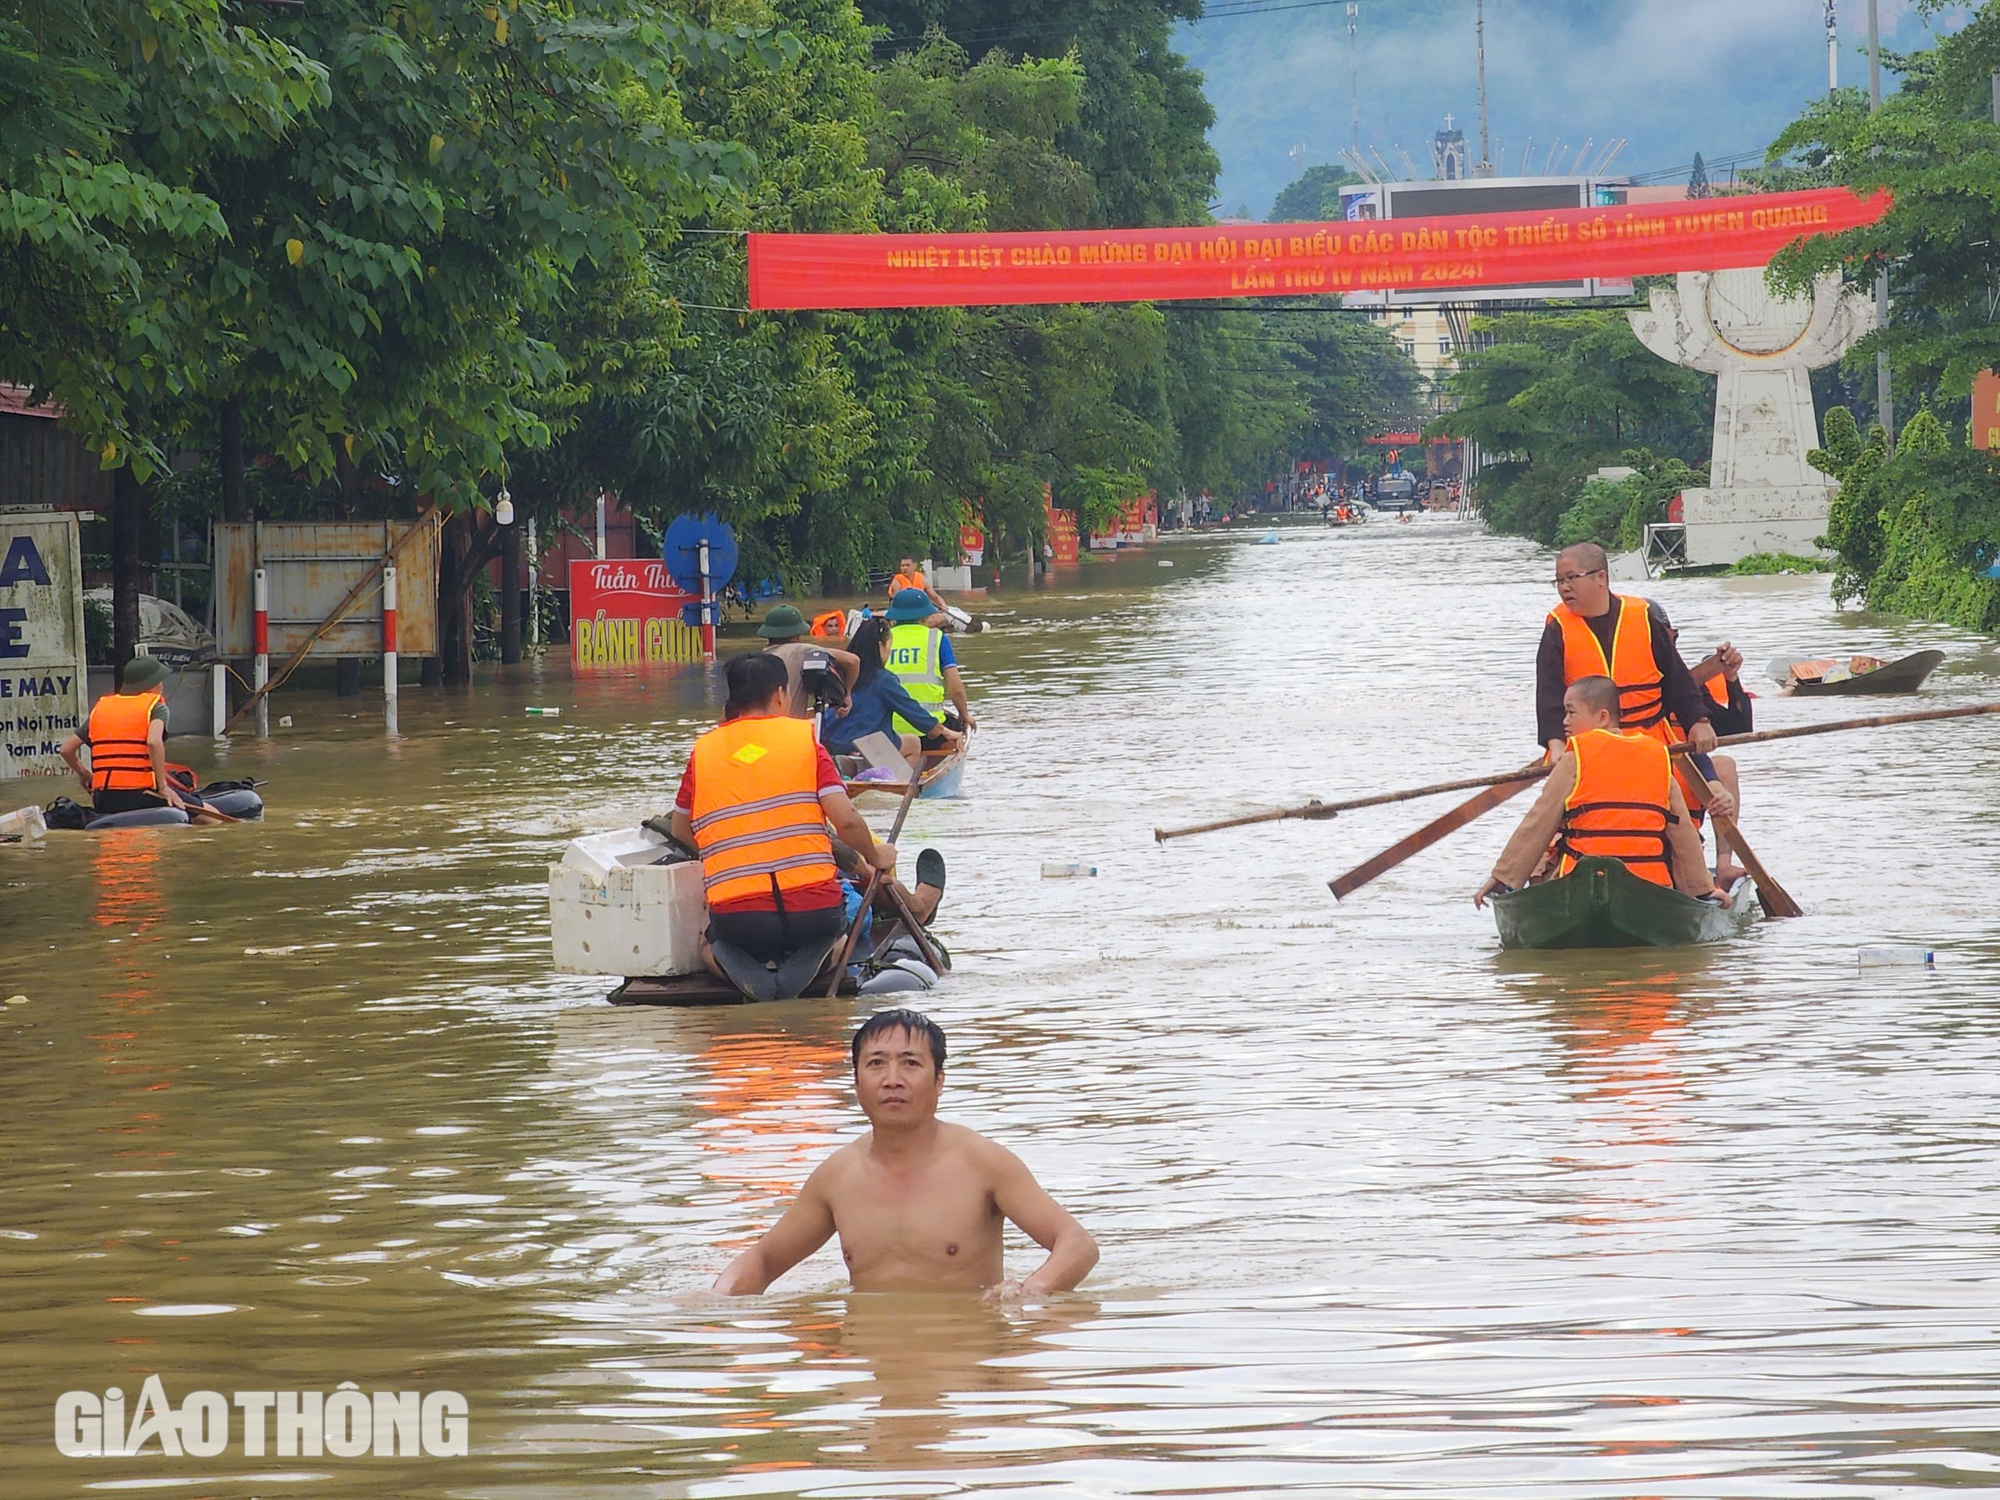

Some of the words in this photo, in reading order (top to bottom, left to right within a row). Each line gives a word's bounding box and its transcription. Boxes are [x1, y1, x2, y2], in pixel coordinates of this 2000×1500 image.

[887, 246, 951, 271] NHIỆT
[958, 244, 1004, 271] LIỆT
[1011, 242, 1071, 266] CHÀO
[1079, 240, 1147, 264] MỪNG
[1154, 241, 1193, 266] ĐẠI
[1200, 236, 1238, 264] HỘI
[1244, 237, 1282, 262] ĐẠI
[1290, 229, 1341, 256] BIỂU
[1349, 229, 1394, 254] CÁC
[1402, 227, 1449, 251] DÂN
[1455, 225, 1498, 252] TỘC
[1505, 216, 1569, 246] THIỂU
[1577, 214, 1607, 242] SỐ
[1614, 212, 1665, 238] TỈNH
[1752, 204, 1829, 231] QUANG
[1231, 264, 1275, 290] LẦN
[1284, 263, 1325, 288] THỨ
[1332, 268, 1352, 286] IV
[1361, 261, 1413, 285] NĂM
[1421, 261, 1483, 282] 2024!
[0, 536, 52, 587] A
[591, 564, 639, 590] Tuấn
[0, 608, 31, 658] E
[577, 609, 641, 668] BÁNH
[18, 668, 72, 698] MÁY
